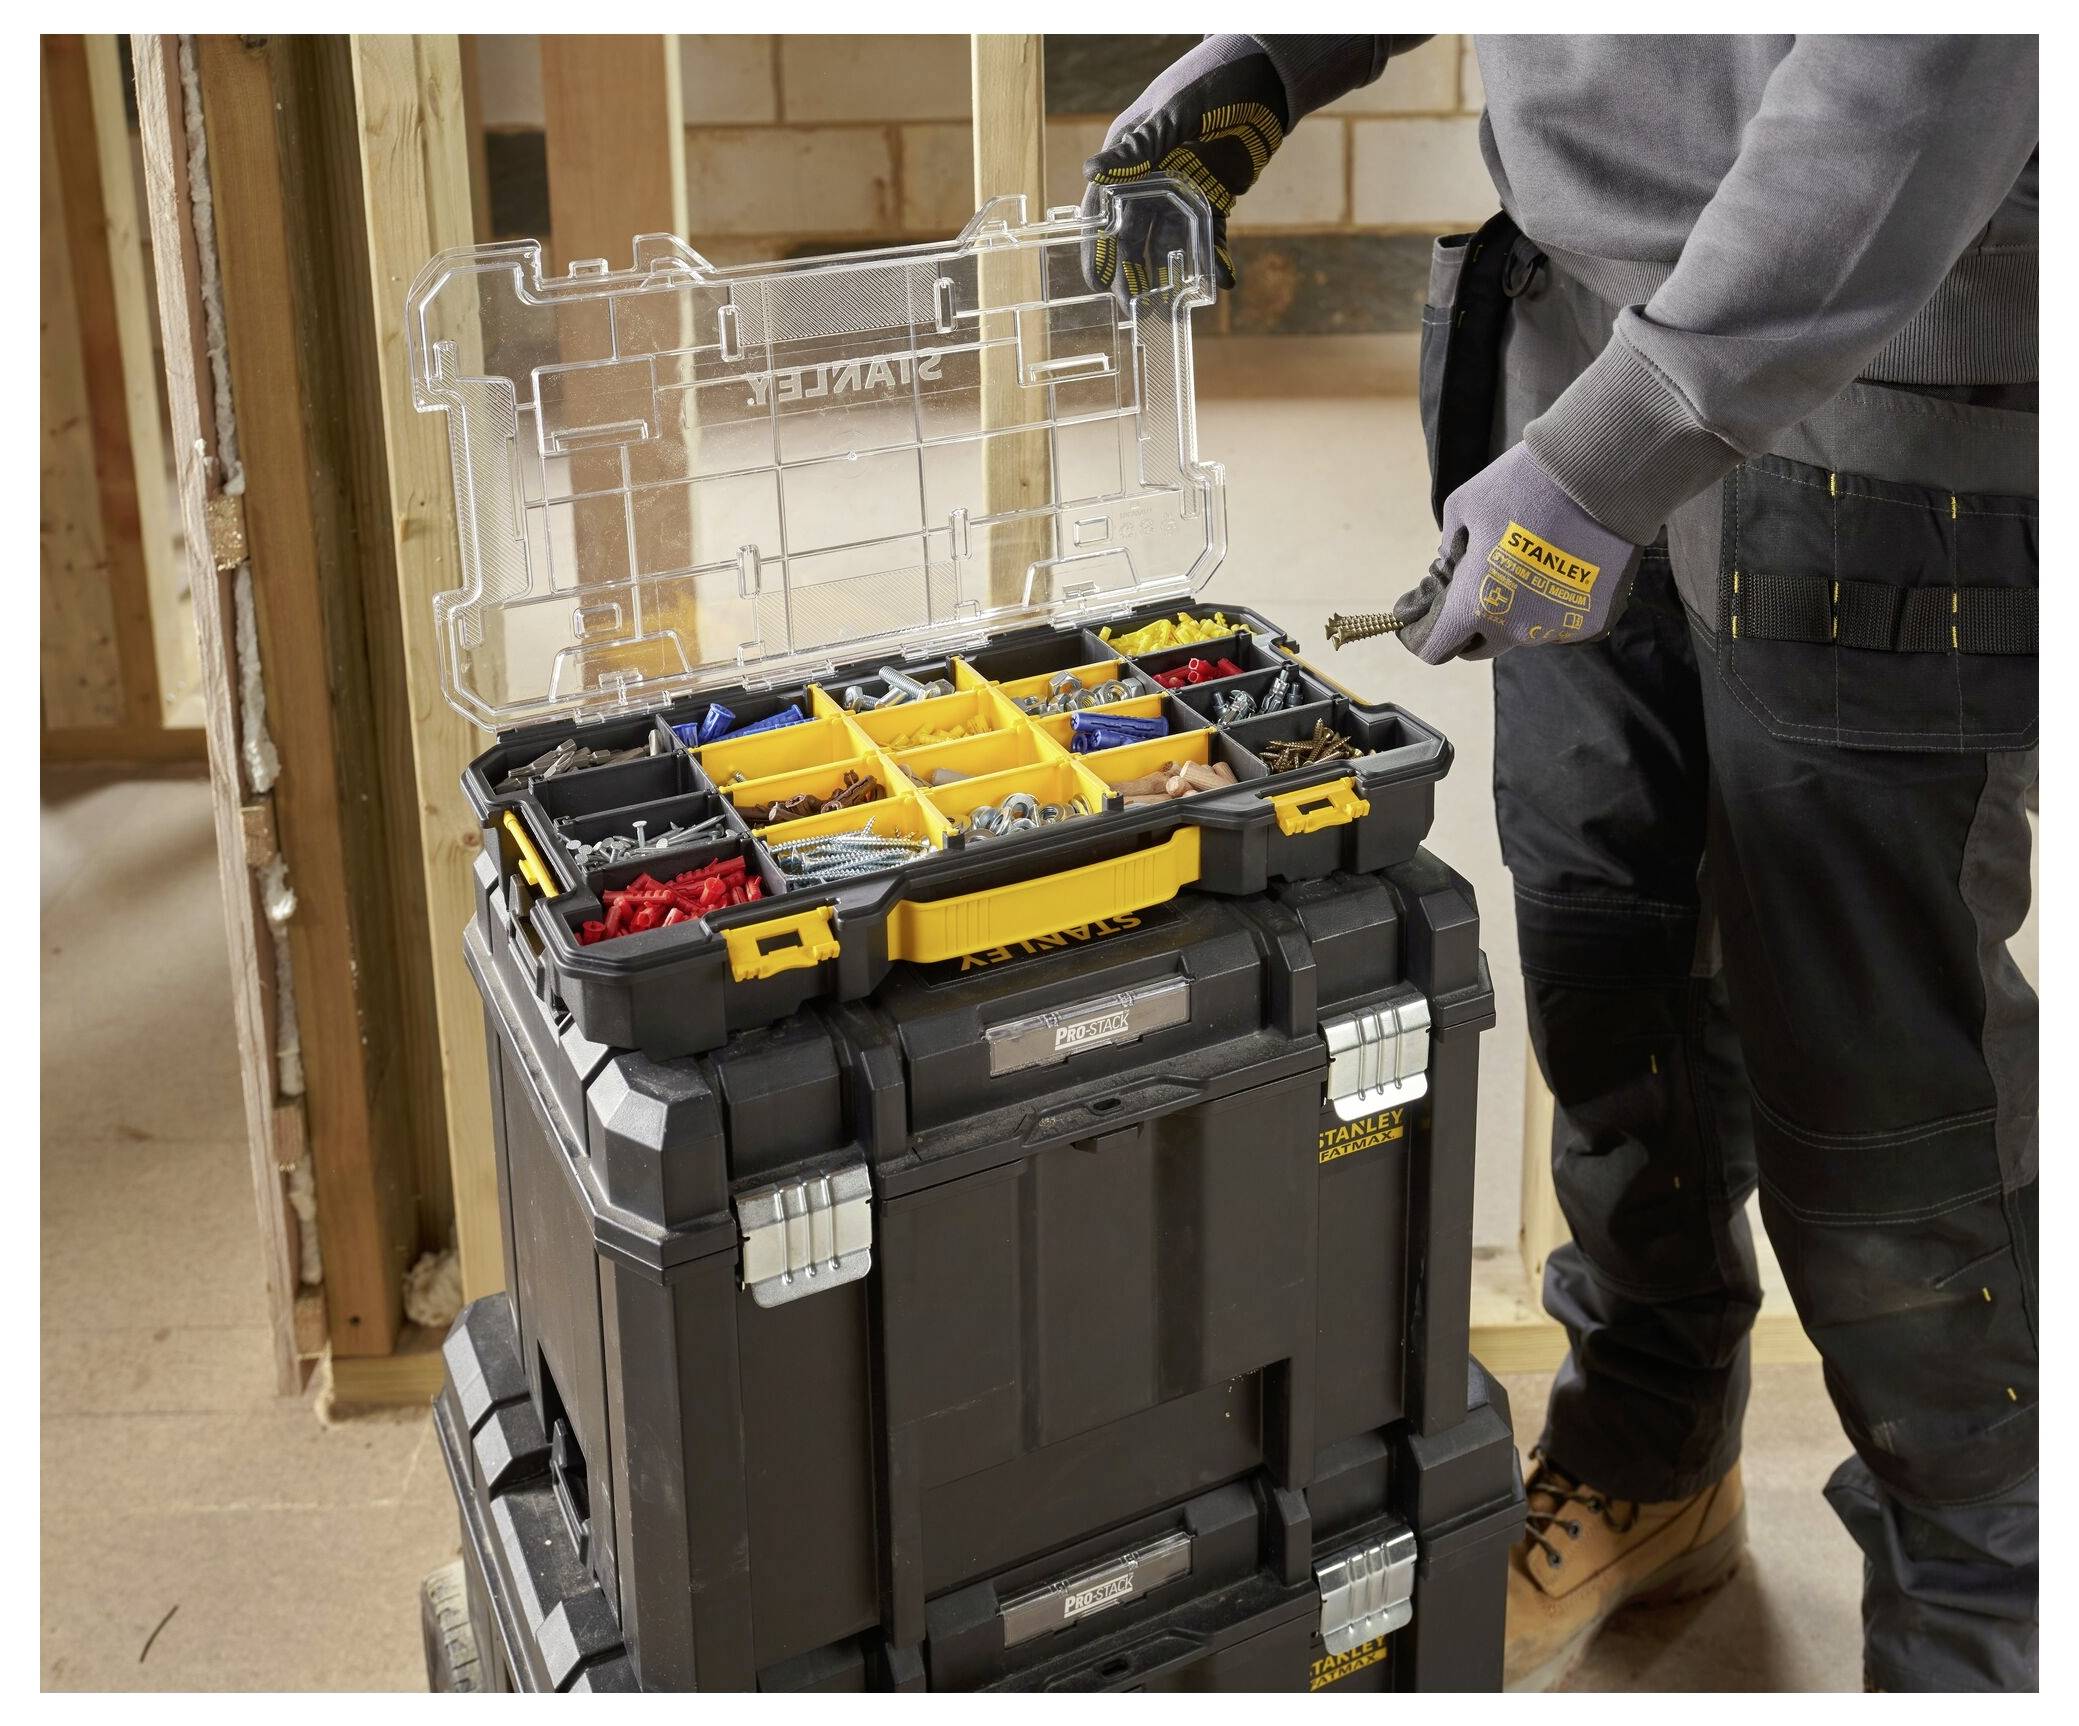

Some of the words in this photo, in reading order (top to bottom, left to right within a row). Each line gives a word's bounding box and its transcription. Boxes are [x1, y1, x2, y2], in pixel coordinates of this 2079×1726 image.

[1508, 531, 1591, 583] STANLEY
[1550, 585, 1586, 605] MEDIUM
[1055, 1012, 1130, 1046] PRO-STACK
[1321, 1130, 1393, 1162] FATMAX
[1064, 1575, 1134, 1614] PRO-STACK
[1309, 1632, 1385, 1677] TANLEY
